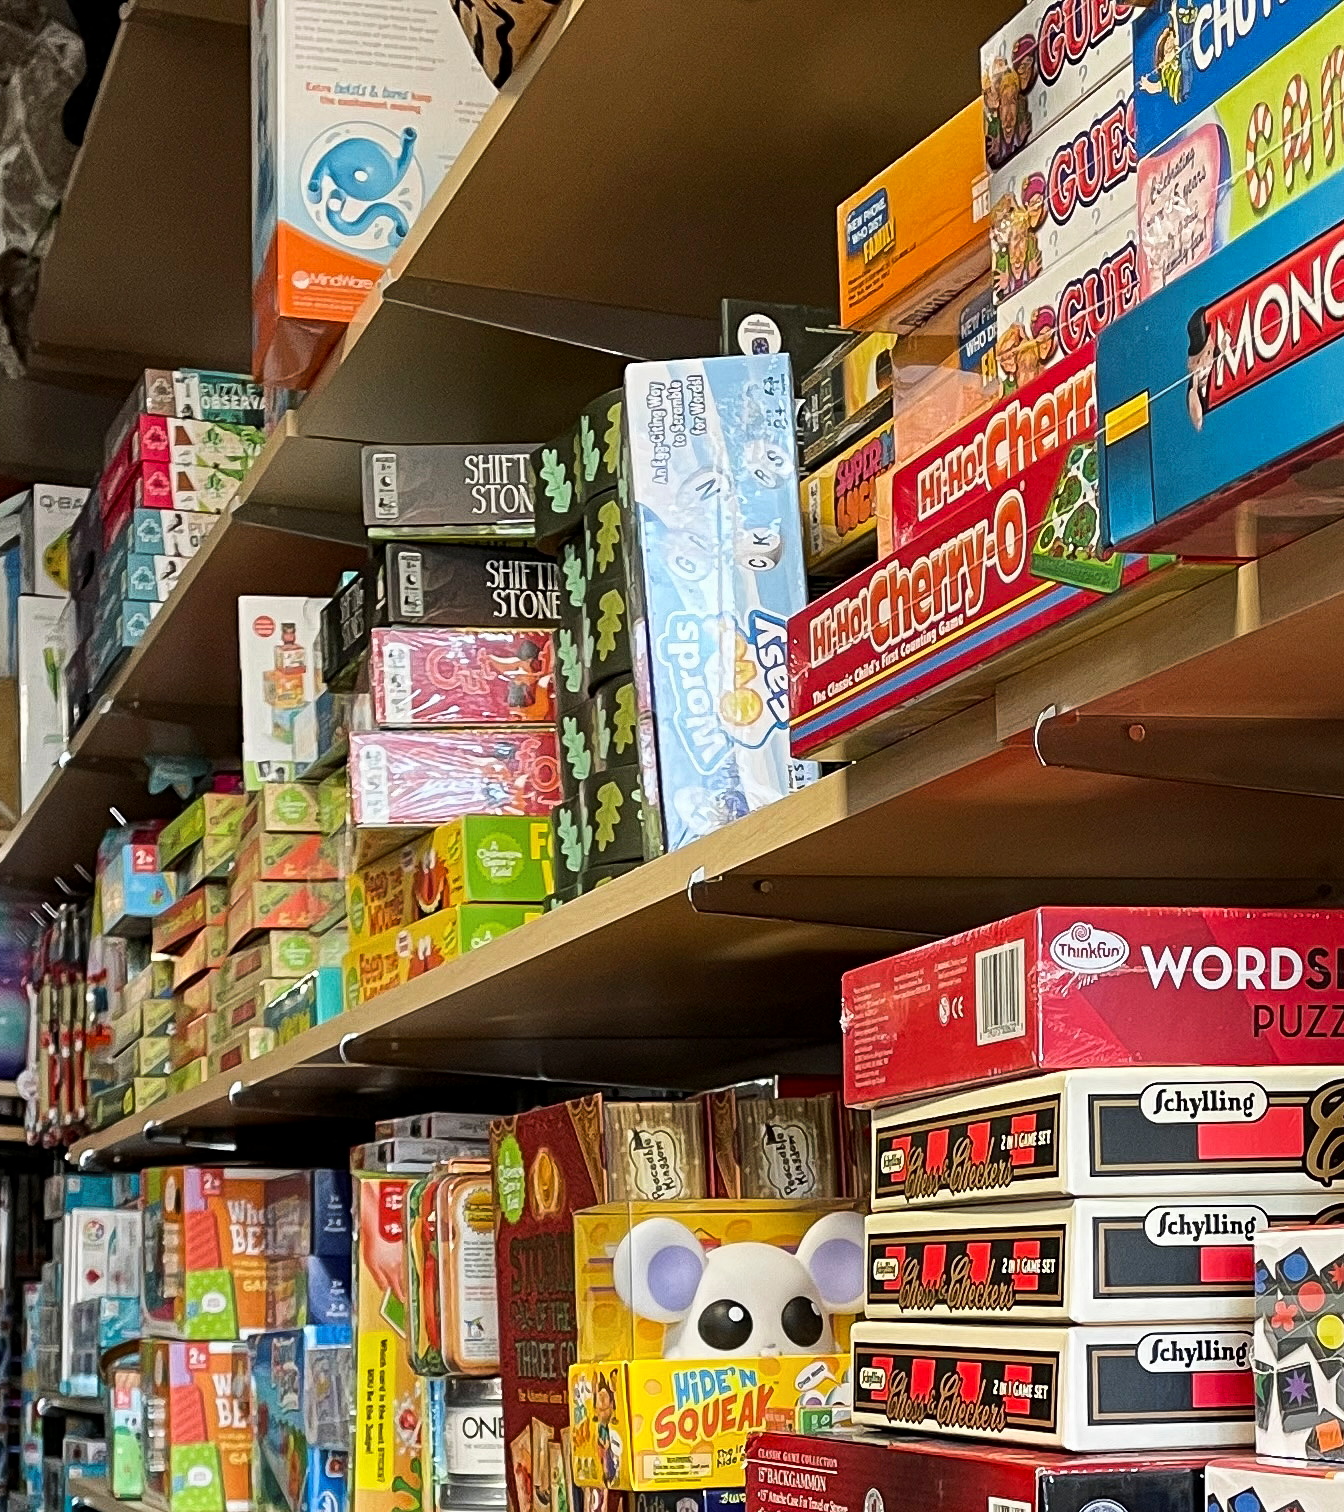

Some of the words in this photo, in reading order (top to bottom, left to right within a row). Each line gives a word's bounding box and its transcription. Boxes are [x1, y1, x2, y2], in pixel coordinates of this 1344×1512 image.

[863, 219, 897, 265] FAMILY
[809, 586, 869, 670] Hi-Ho!
[867, 487, 1027, 654] Cherry-O
[812, 690, 827, 706] The
[827, 673, 854, 701] Classic
[854, 657, 881, 684] Child's
[881, 648, 900, 670] First
[900, 628, 938, 659] Counting
[1152, 1088, 1256, 1118] Schylling
[1156, 1214, 1257, 1243] Schylling
[1152, 1336, 1249, 1367] Schylling
[654, 1383, 776, 1451] SQUEAK
[757, 1448, 782, 1462] CLASSIC
[782, 1451, 800, 1465] GAME
[800, 1453, 838, 1469] COLLECTION
